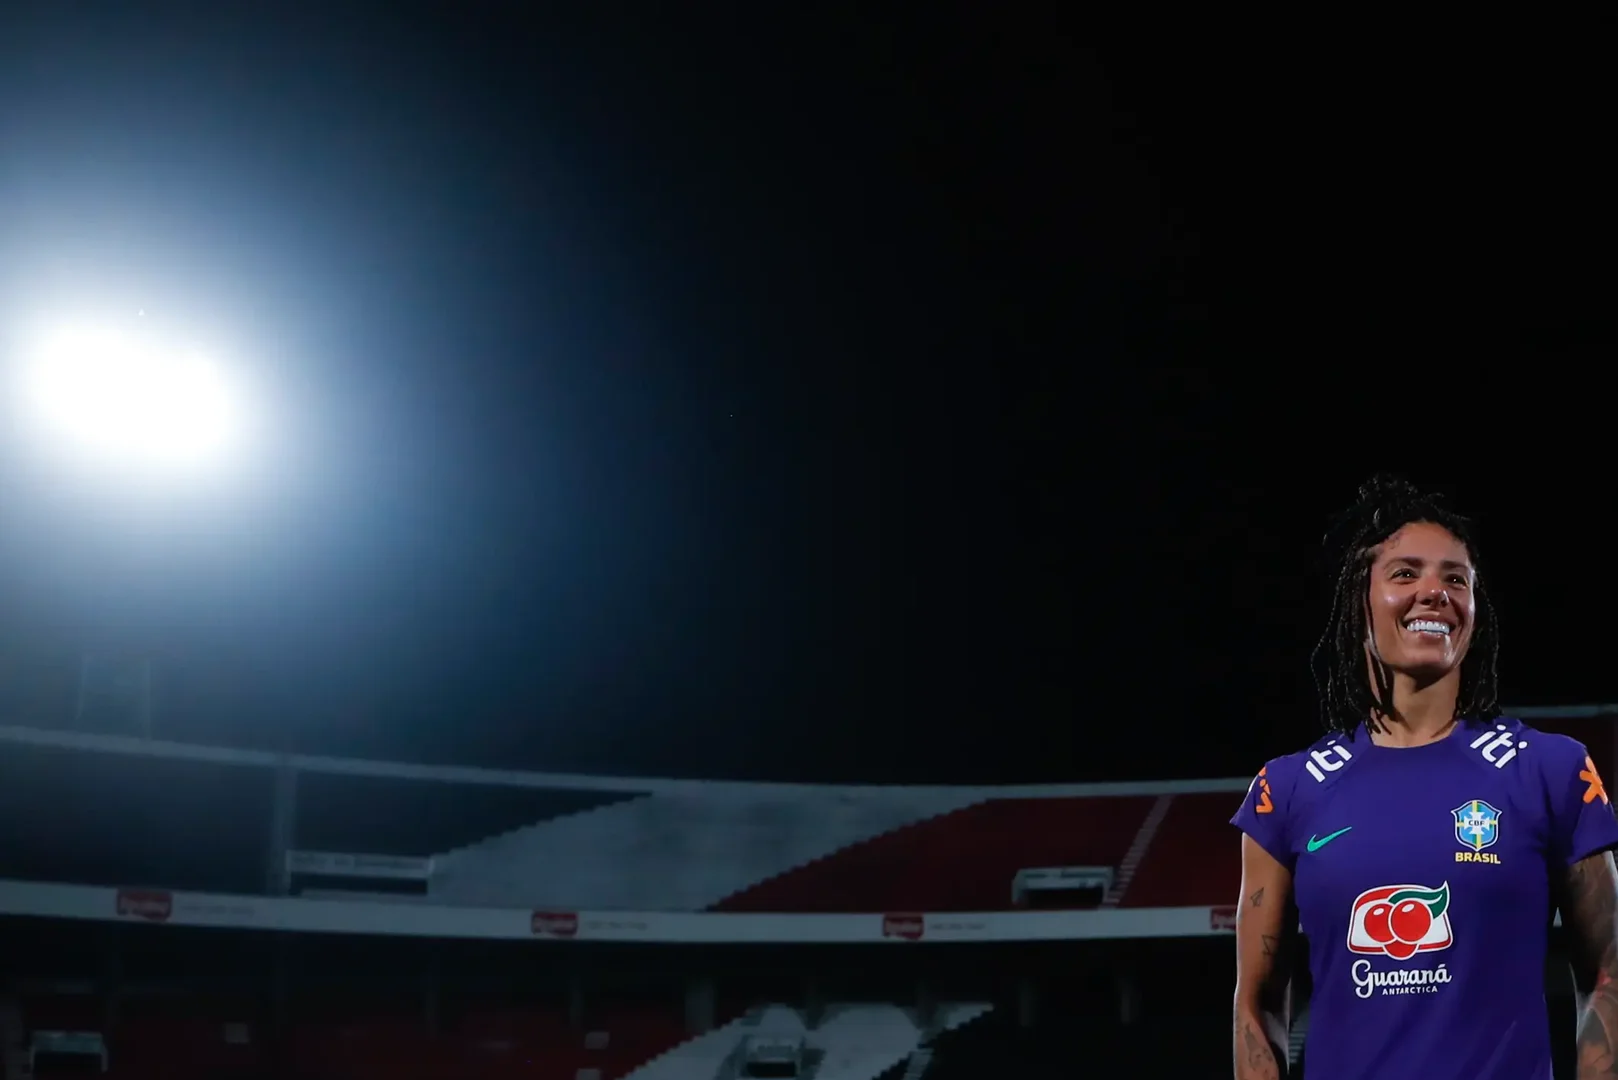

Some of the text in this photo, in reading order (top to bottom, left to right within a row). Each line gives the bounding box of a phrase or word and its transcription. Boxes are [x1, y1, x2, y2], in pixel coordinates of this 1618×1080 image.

[1470, 724, 1527, 769] iti
[1305, 739, 1353, 783] iti
[1468, 819, 1486, 827] CBF
[1455, 852, 1501, 864] BRASIL
[1351, 959, 1452, 999] Guaraná
[1382, 985, 1438, 996] ANTARCTICA
